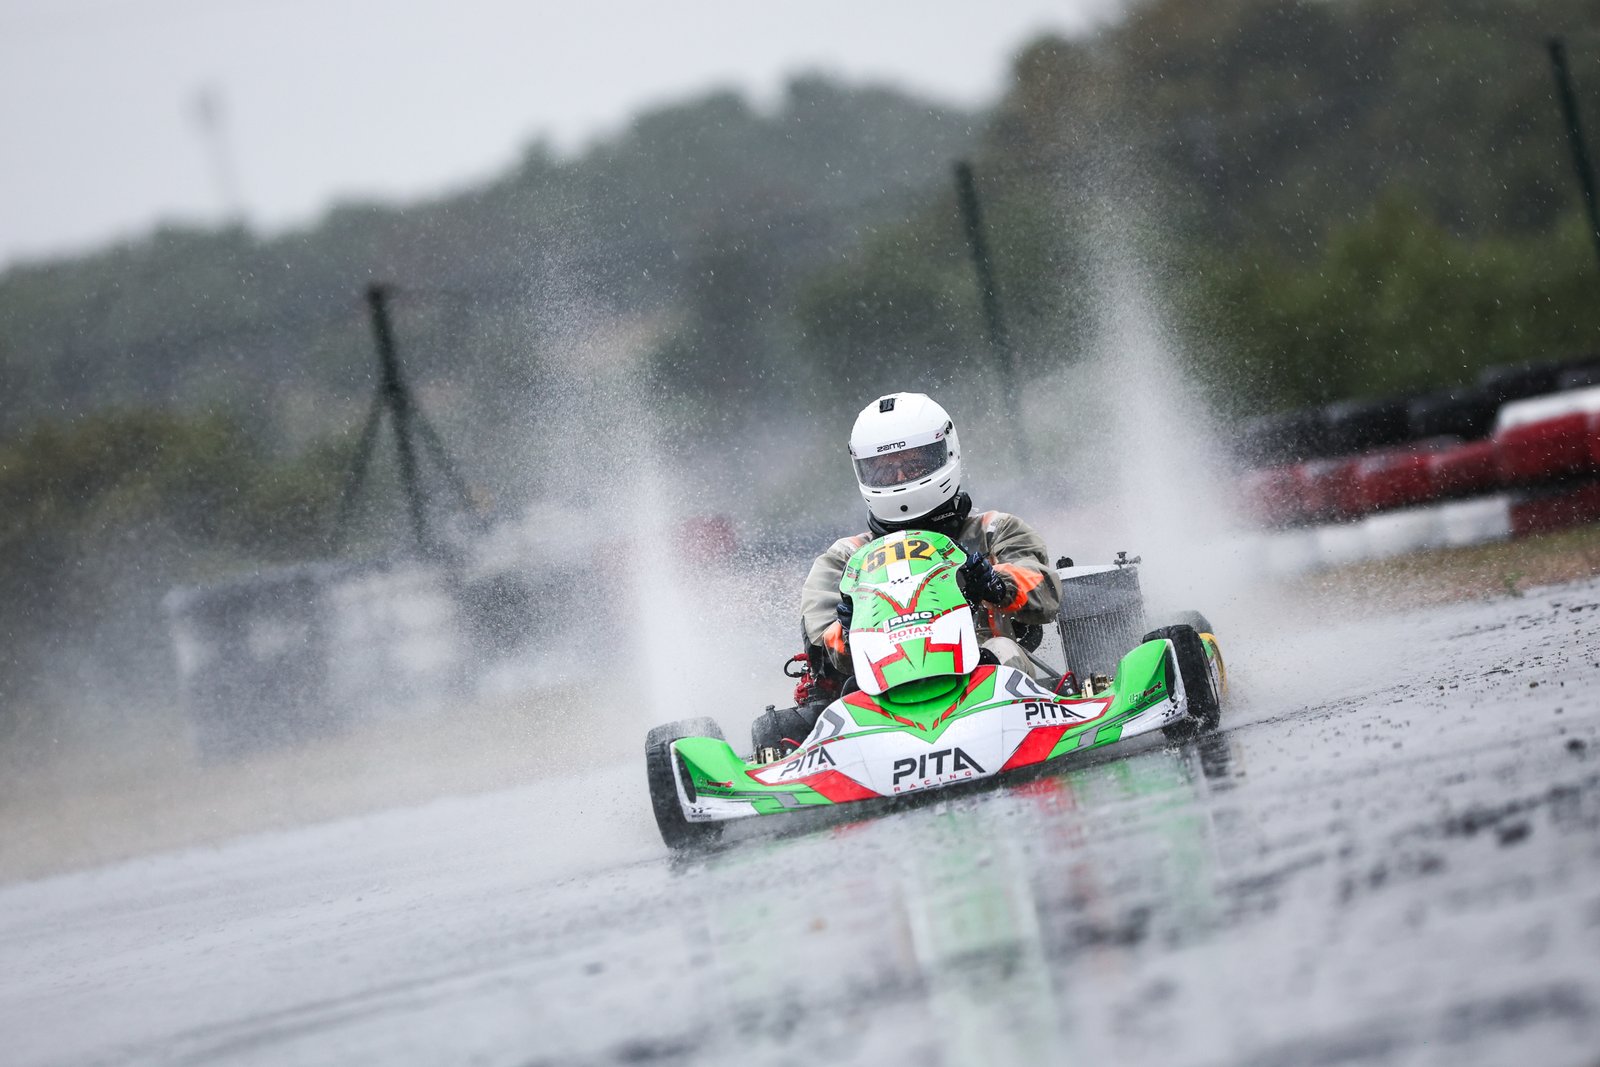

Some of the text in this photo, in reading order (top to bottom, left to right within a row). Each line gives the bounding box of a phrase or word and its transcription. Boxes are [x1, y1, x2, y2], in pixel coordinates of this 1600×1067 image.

[876, 440, 906, 453] zamp
[866, 539, 932, 573] 512
[889, 611, 933, 626] RMC
[888, 625, 933, 641] ROTAX
[1024, 702, 1087, 721] PITA
[780, 746, 836, 777] PITA
[893, 747, 986, 785] PITA
[893, 770, 972, 793] RACING
